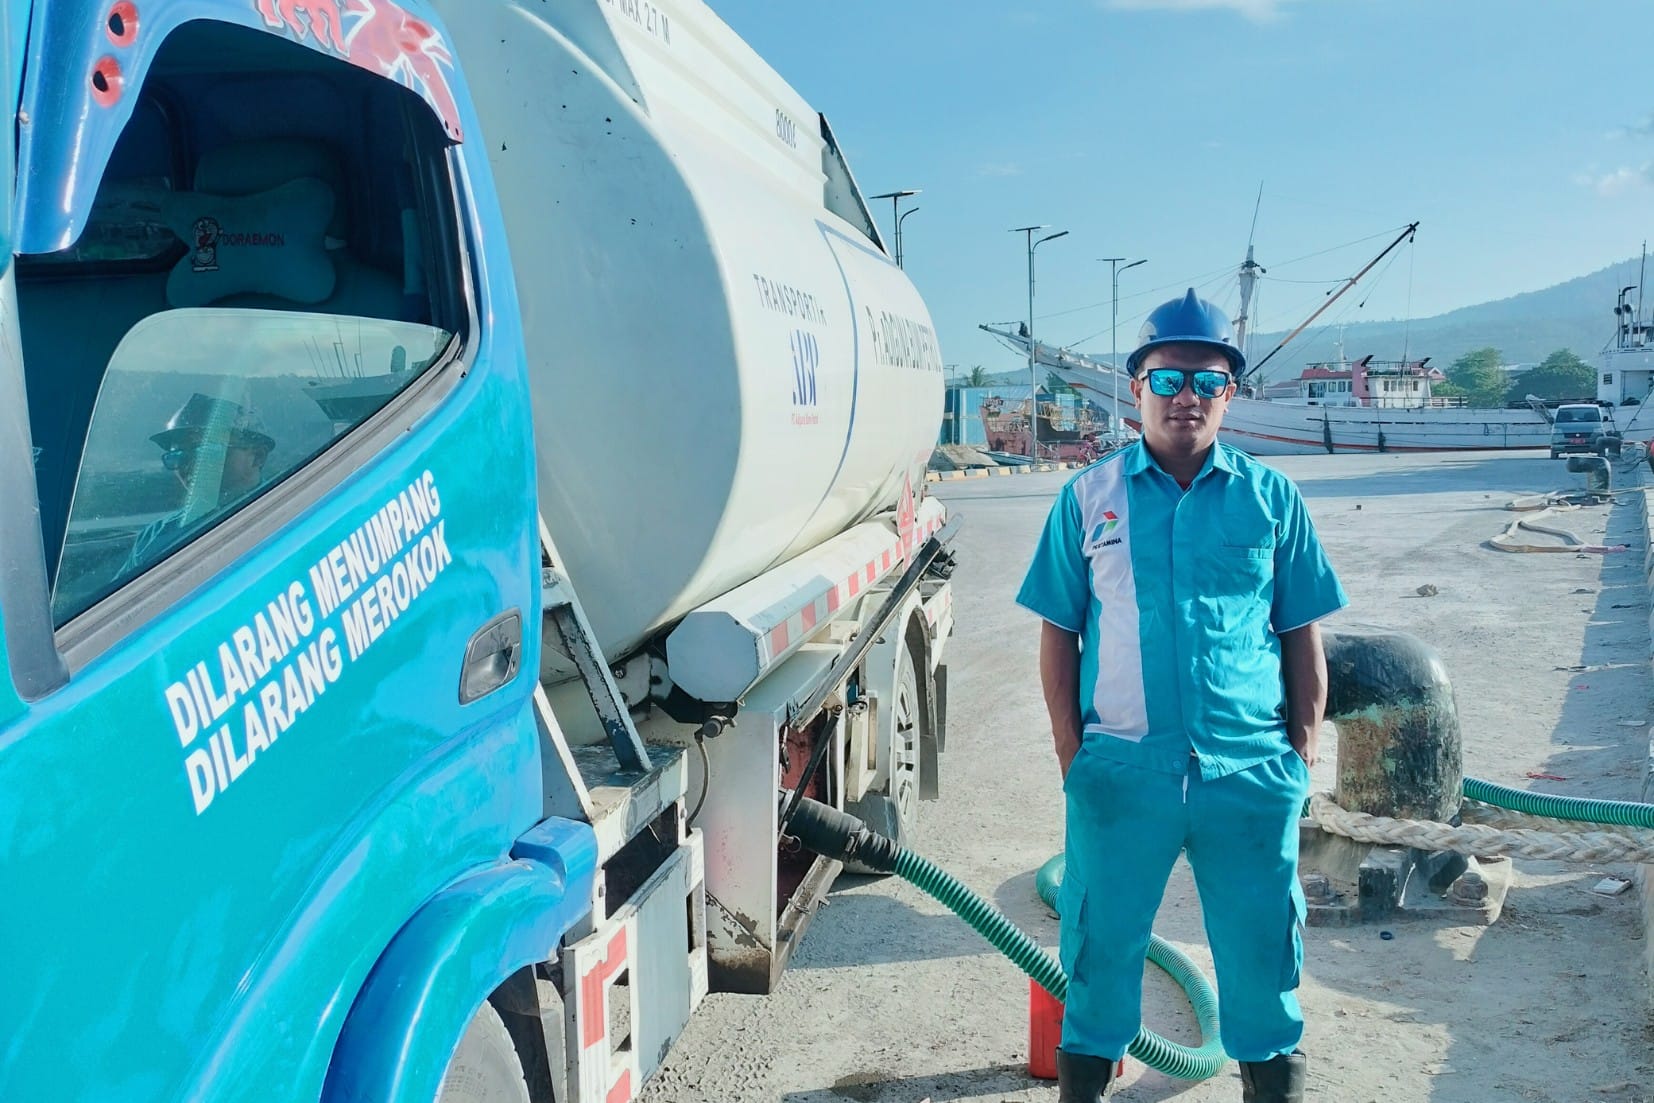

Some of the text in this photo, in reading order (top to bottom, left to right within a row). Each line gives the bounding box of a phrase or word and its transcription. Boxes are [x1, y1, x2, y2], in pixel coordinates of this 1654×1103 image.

[223, 232, 285, 247] DORAEMON
[165, 469, 441, 749] DILARANG MENUMPANG
[185, 518, 453, 816] DILARANG MEROKOK
